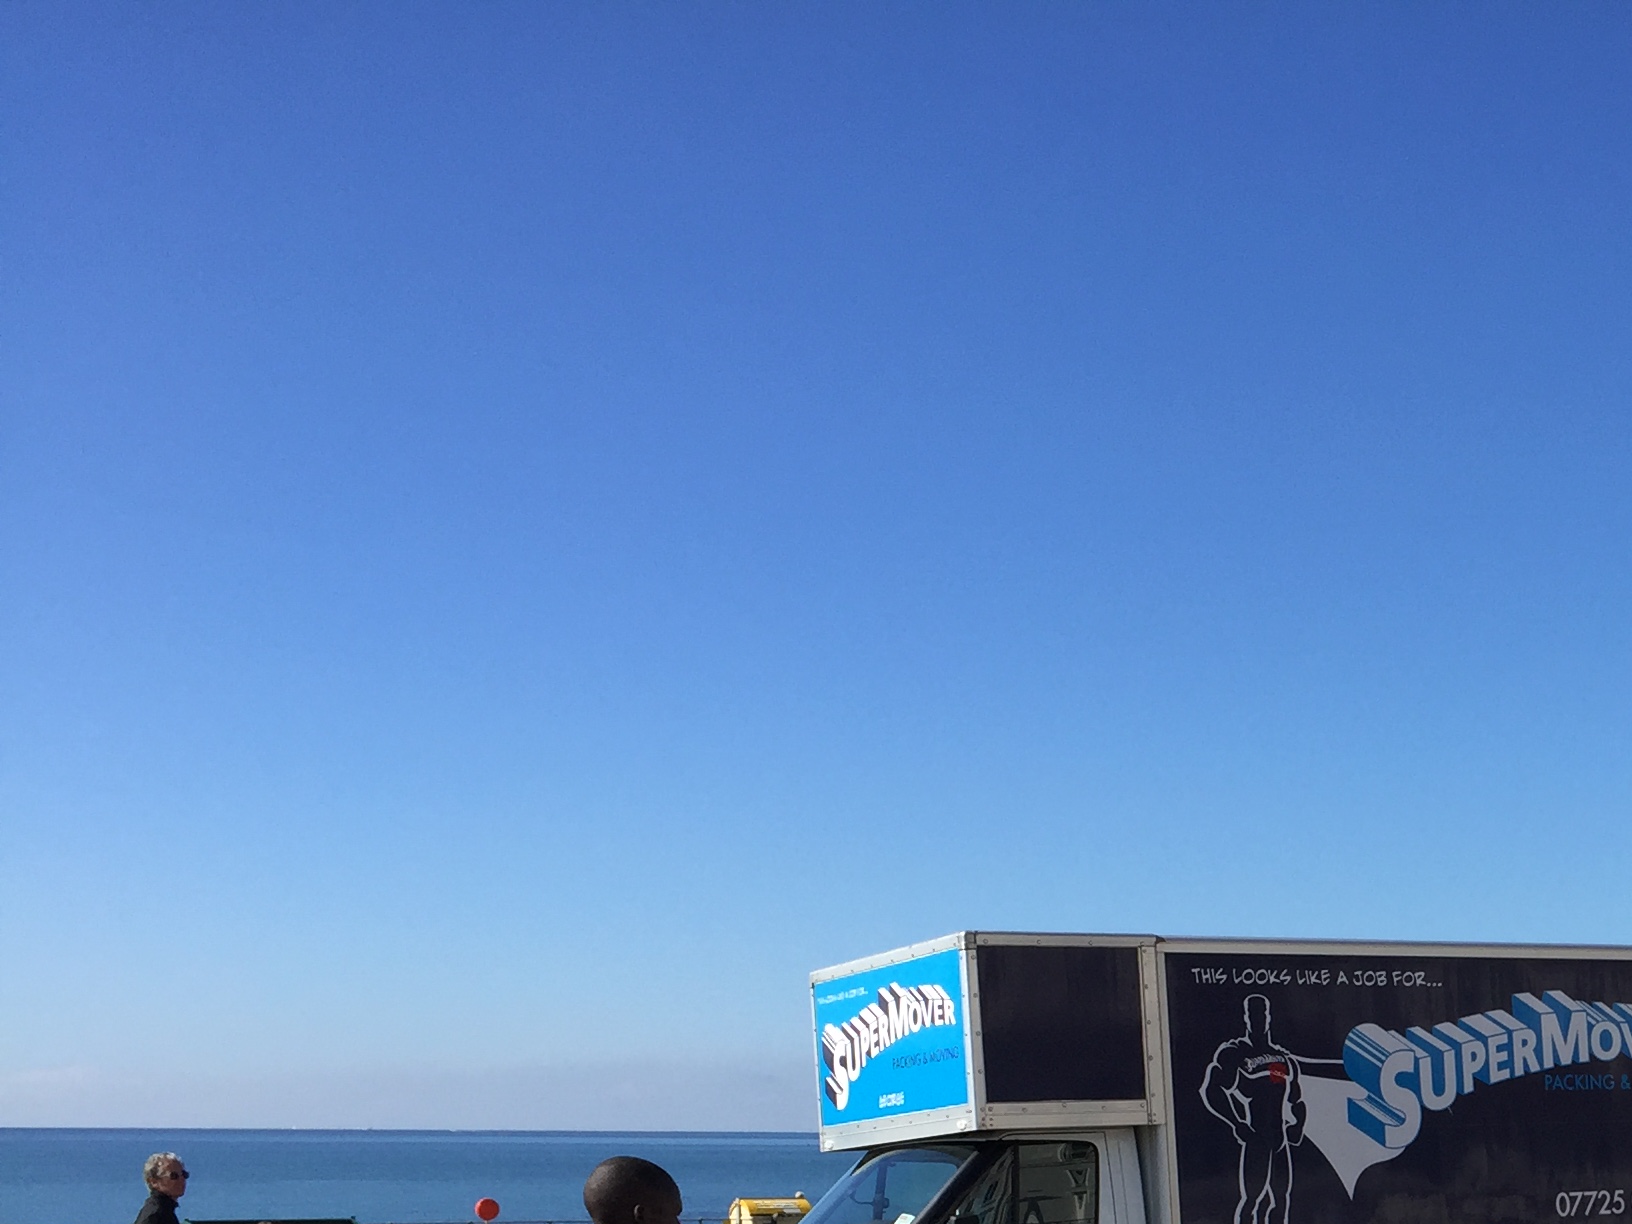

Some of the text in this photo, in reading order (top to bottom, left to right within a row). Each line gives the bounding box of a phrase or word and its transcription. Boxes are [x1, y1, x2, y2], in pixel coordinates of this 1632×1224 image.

[1191, 967, 1443, 987] THIS LOOKS LIKE A JOB FOR...
[892, 1053, 921, 1069] PACKING
[930, 1046, 959, 1064] MOVING
[1544, 1073, 1615, 1091] PACKING
[1620, 1073, 1631, 1090] &
[1555, 1189, 1626, 1217] 07725
